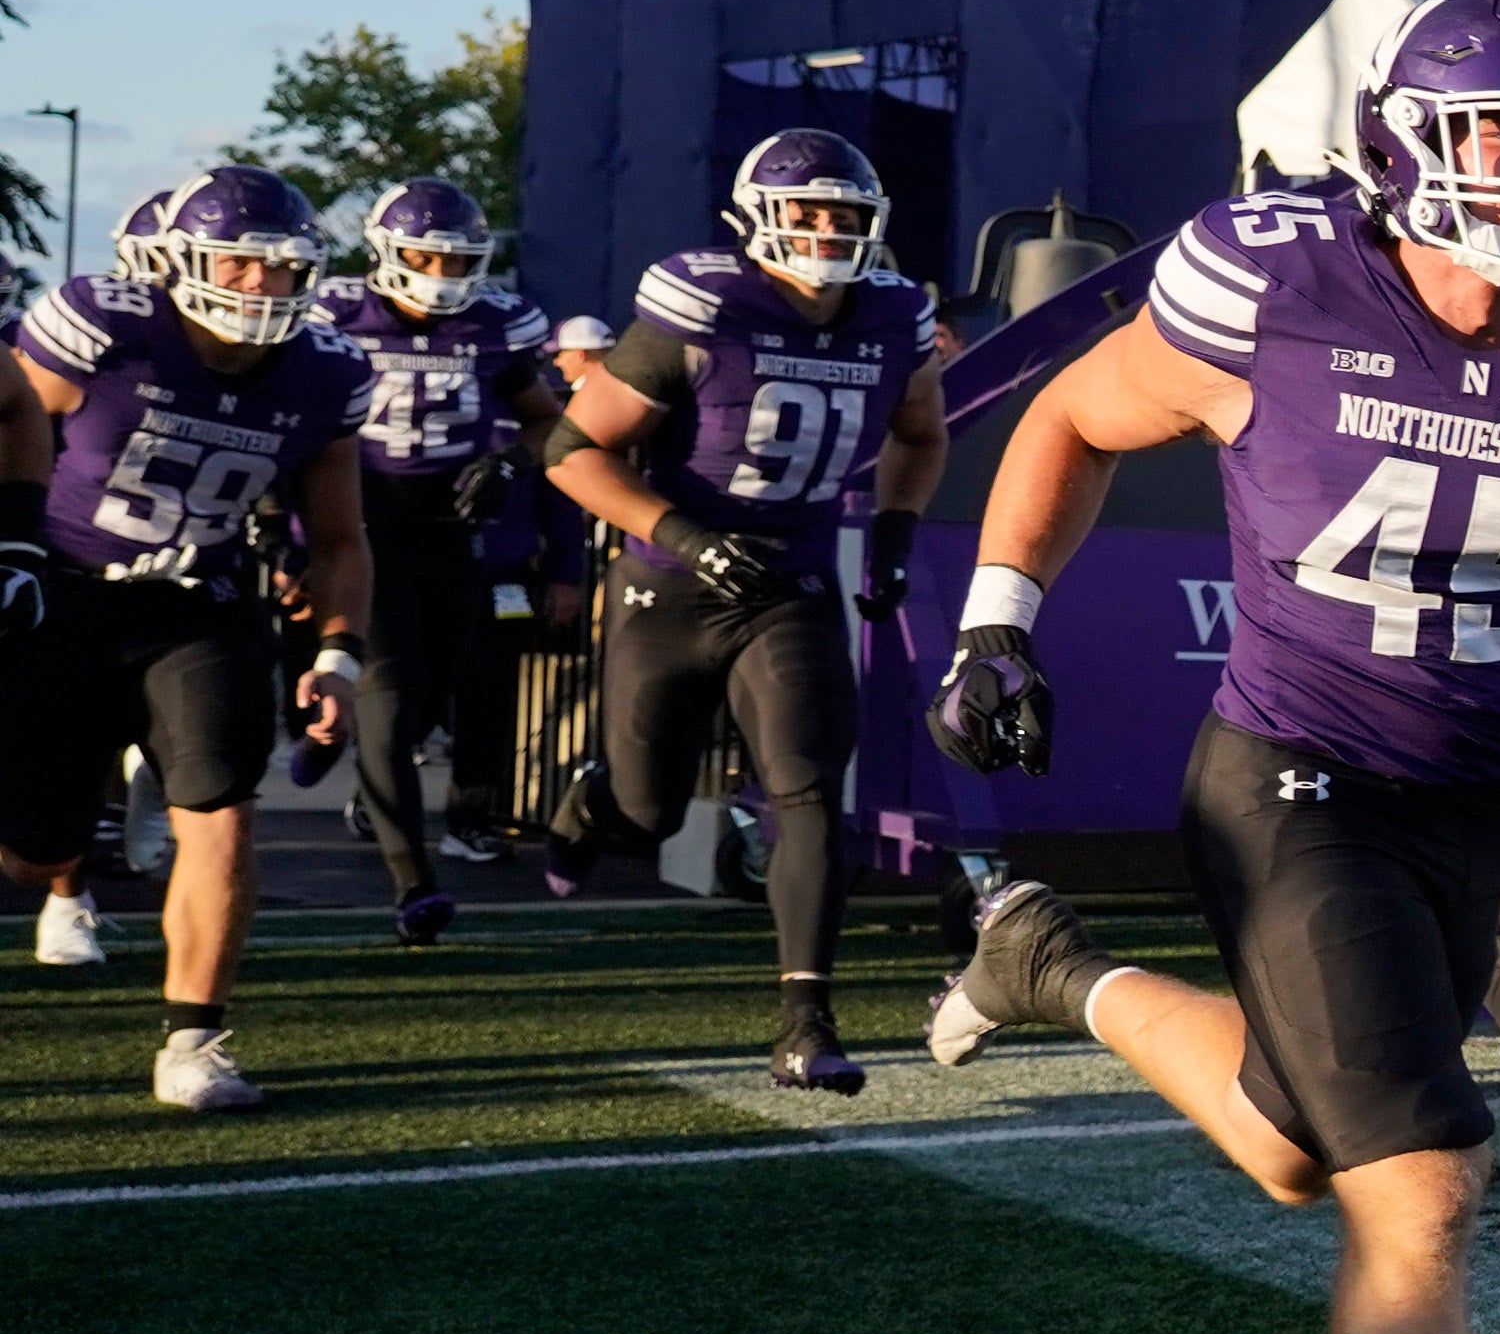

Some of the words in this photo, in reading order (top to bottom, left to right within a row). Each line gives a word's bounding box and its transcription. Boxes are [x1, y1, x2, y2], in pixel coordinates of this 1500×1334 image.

[358, 371, 481, 459] 42
[1463, 359, 1491, 396] N
[93, 430, 277, 547] 59
[728, 380, 867, 504] 91
